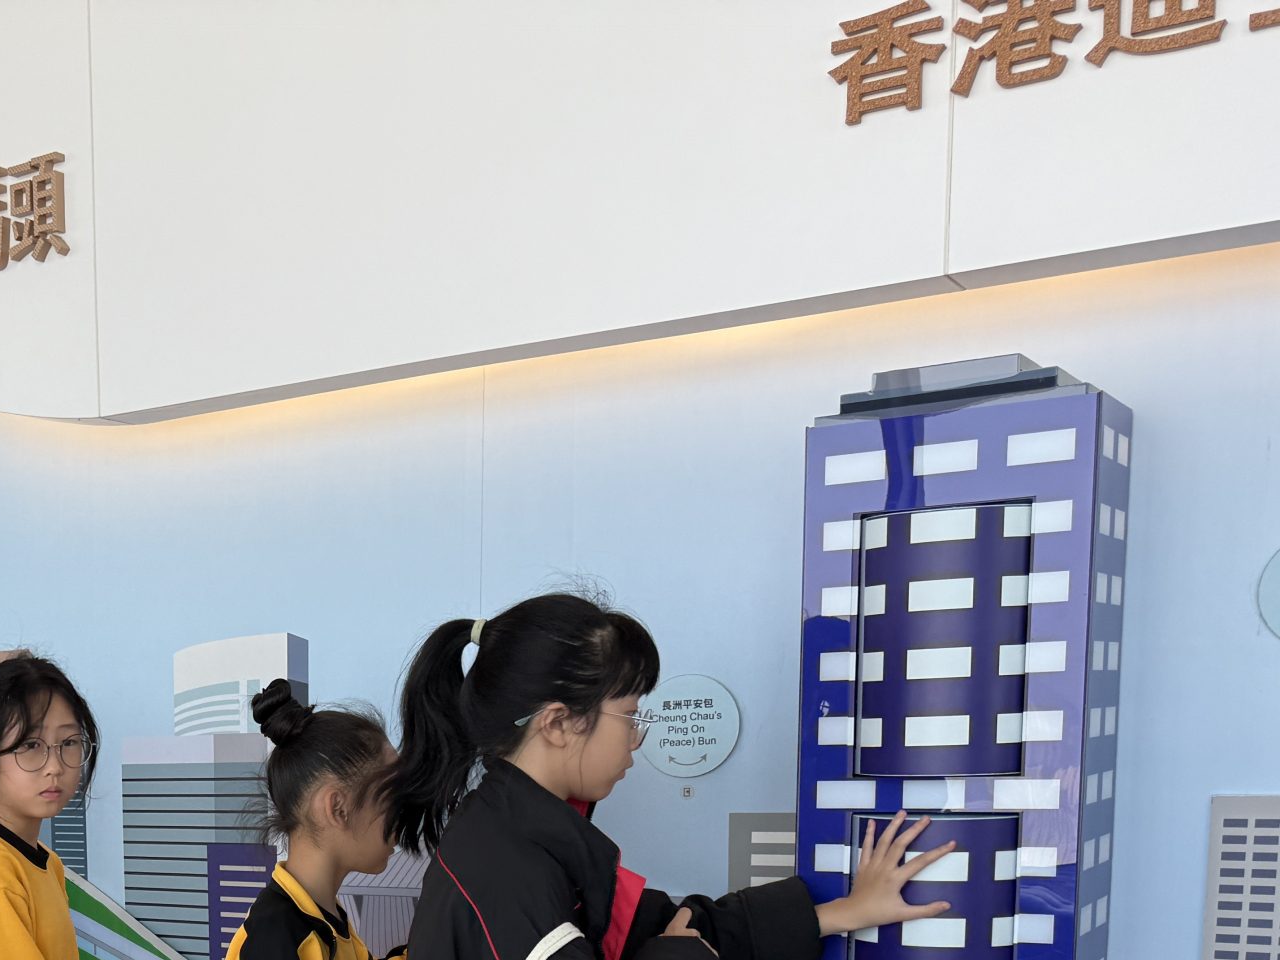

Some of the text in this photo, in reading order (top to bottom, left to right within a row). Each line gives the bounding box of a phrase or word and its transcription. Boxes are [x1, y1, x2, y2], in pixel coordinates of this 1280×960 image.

[827, 0, 1280, 126] 香港迪
[662, 698, 714, 711] 長洲平安包
[653, 711, 722, 723] Cheung Chau's
[668, 725, 705, 736] Ping On
[660, 736, 717, 748] (Peace) Bun
